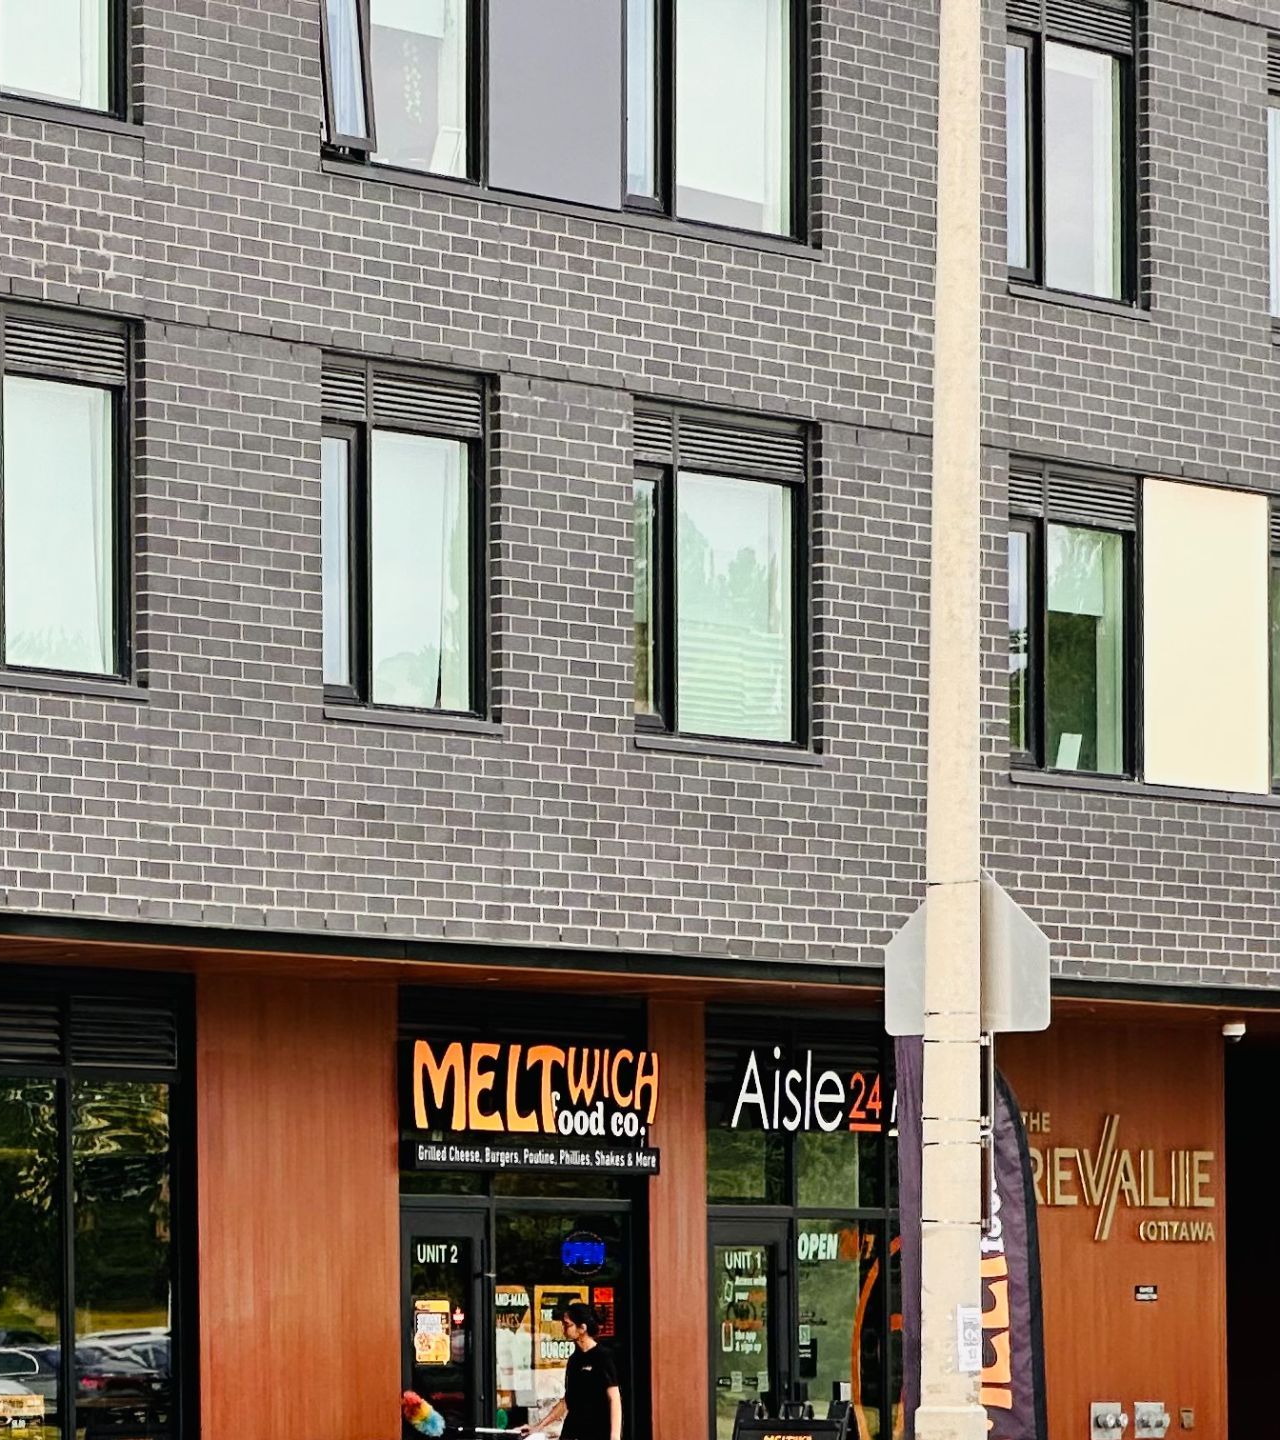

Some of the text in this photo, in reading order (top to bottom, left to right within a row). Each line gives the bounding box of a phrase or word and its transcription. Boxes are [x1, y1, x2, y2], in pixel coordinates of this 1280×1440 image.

[550, 1091, 646, 1136] food co.
[1020, 1111, 1051, 1133] THE
[418, 1145, 446, 1161] Grilled
[449, 1146, 482, 1163] Cheese,
[485, 1147, 521, 1167] Burgers,
[523, 1149, 557, 1165] Poutine,
[595, 1150, 625, 1167] Shakes
[627, 1152, 633, 1166] &
[635, 1152, 656, 1168] More
[1140, 1221, 1215, 1241] OTTAWA
[417, 1244, 458, 1264] UNIT 2
[798, 1232, 838, 1260] OPEN
[724, 1252, 762, 1270] UNIT 1
